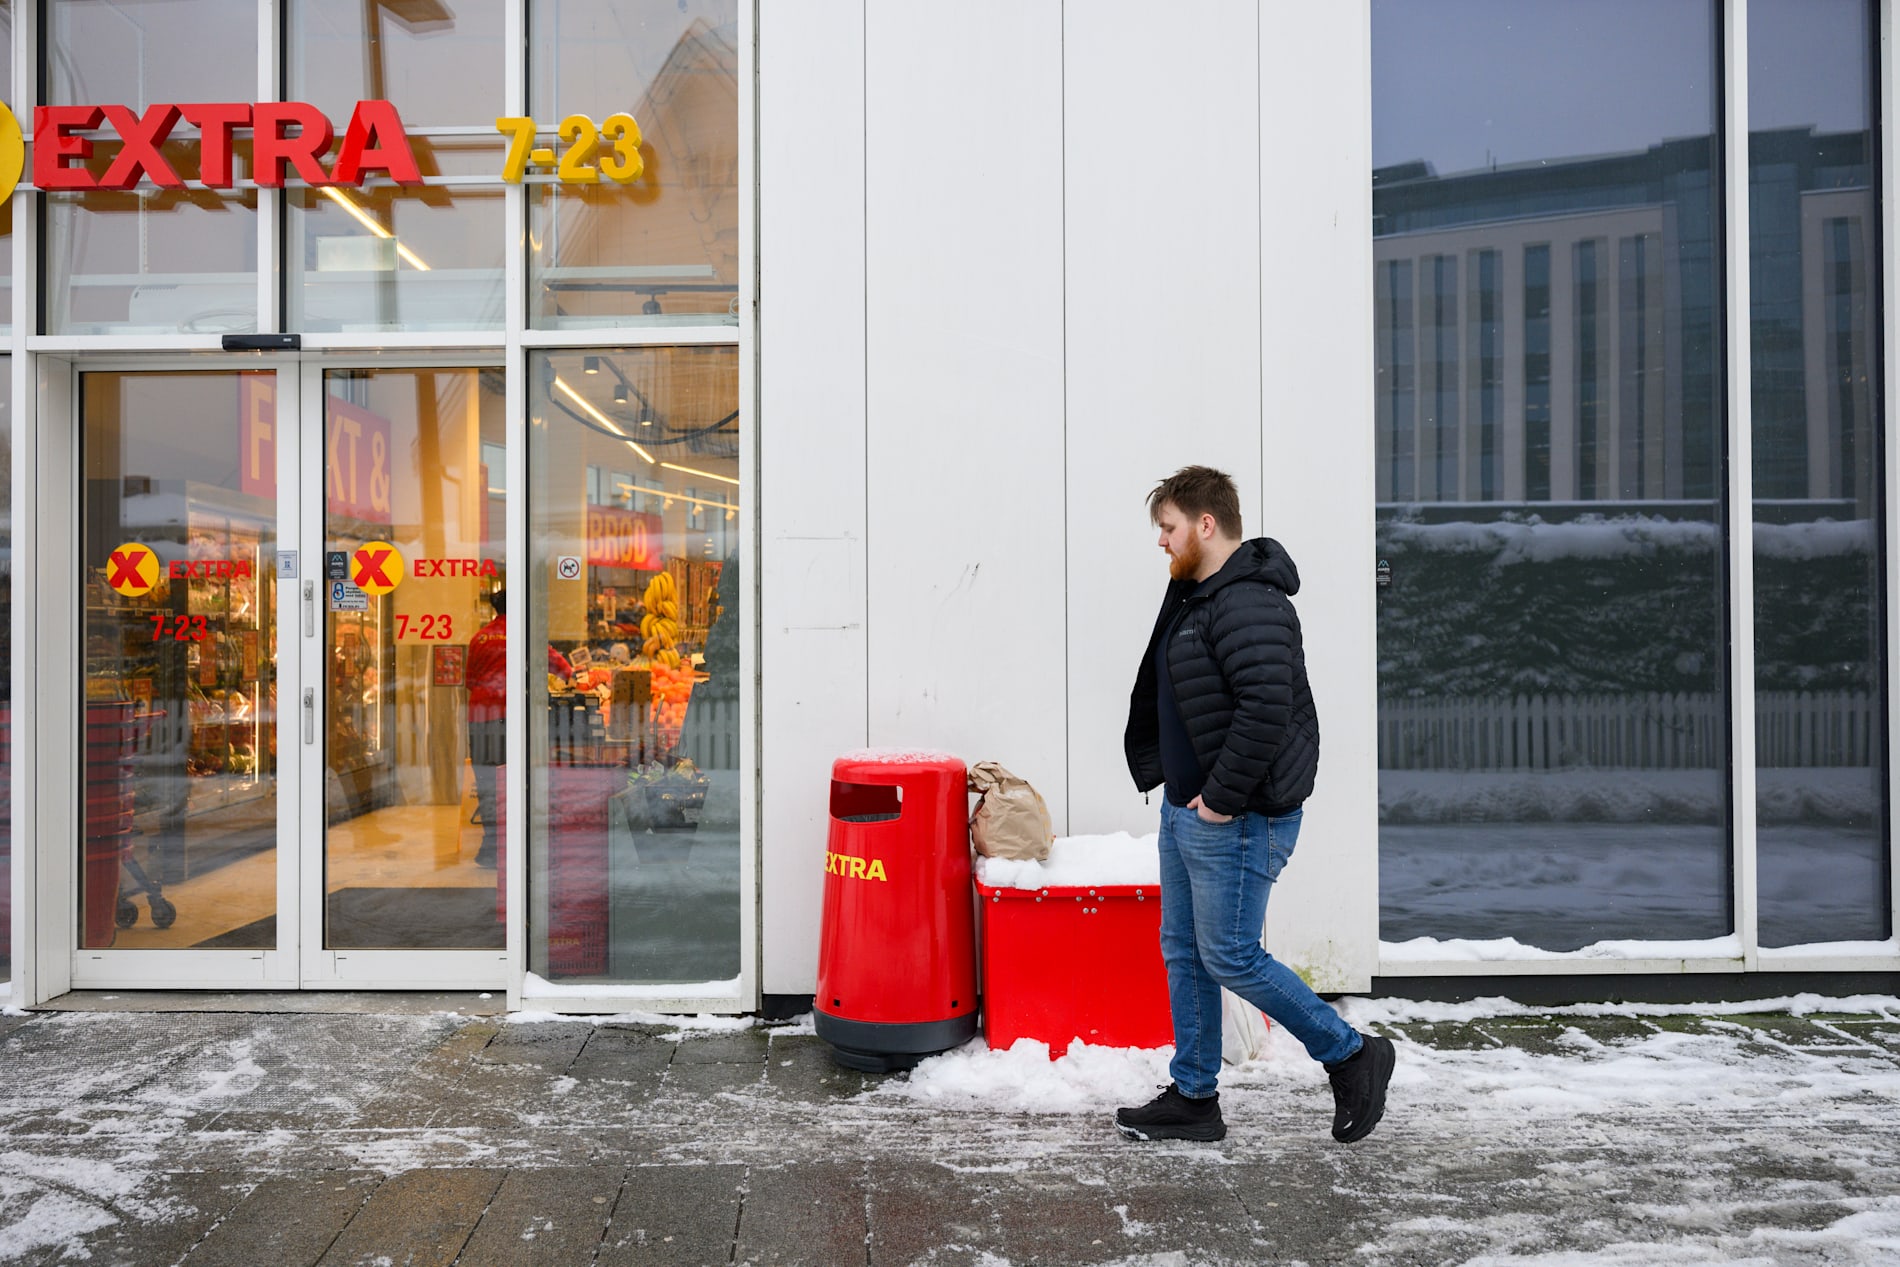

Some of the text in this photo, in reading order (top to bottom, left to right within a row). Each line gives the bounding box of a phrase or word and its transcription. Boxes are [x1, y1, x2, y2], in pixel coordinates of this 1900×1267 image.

[33, 99, 424, 190] EXTRA
[496, 112, 645, 184] 7-23
[370, 430, 391, 513] &
[169, 560, 252, 579] EXTRA
[414, 559, 498, 577] EXTRA
[150, 614, 207, 641] 7-23
[395, 613, 453, 641] 7-23
